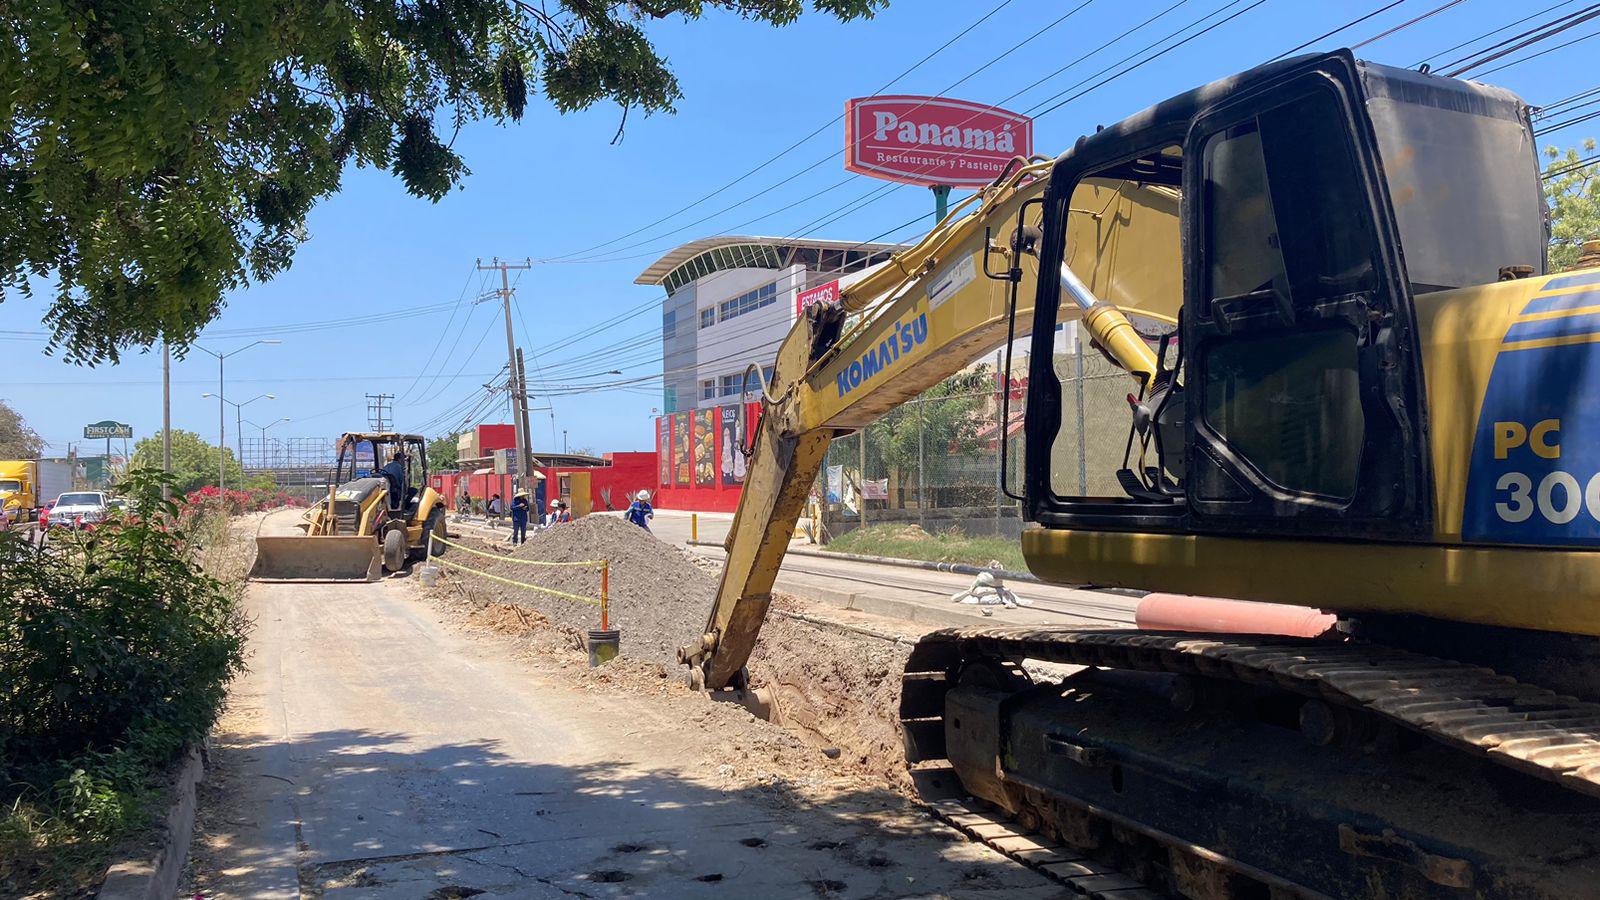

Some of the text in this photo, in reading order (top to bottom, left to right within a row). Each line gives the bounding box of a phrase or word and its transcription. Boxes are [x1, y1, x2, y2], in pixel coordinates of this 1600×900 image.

[873, 111, 1015, 152] Panamá
[877, 152, 946, 166] Restaurante
[949, 160, 957, 169] y
[837, 313, 928, 398] KOMATSU
[87, 426, 109, 434] FIRST
[1494, 419, 1560, 459] PC
